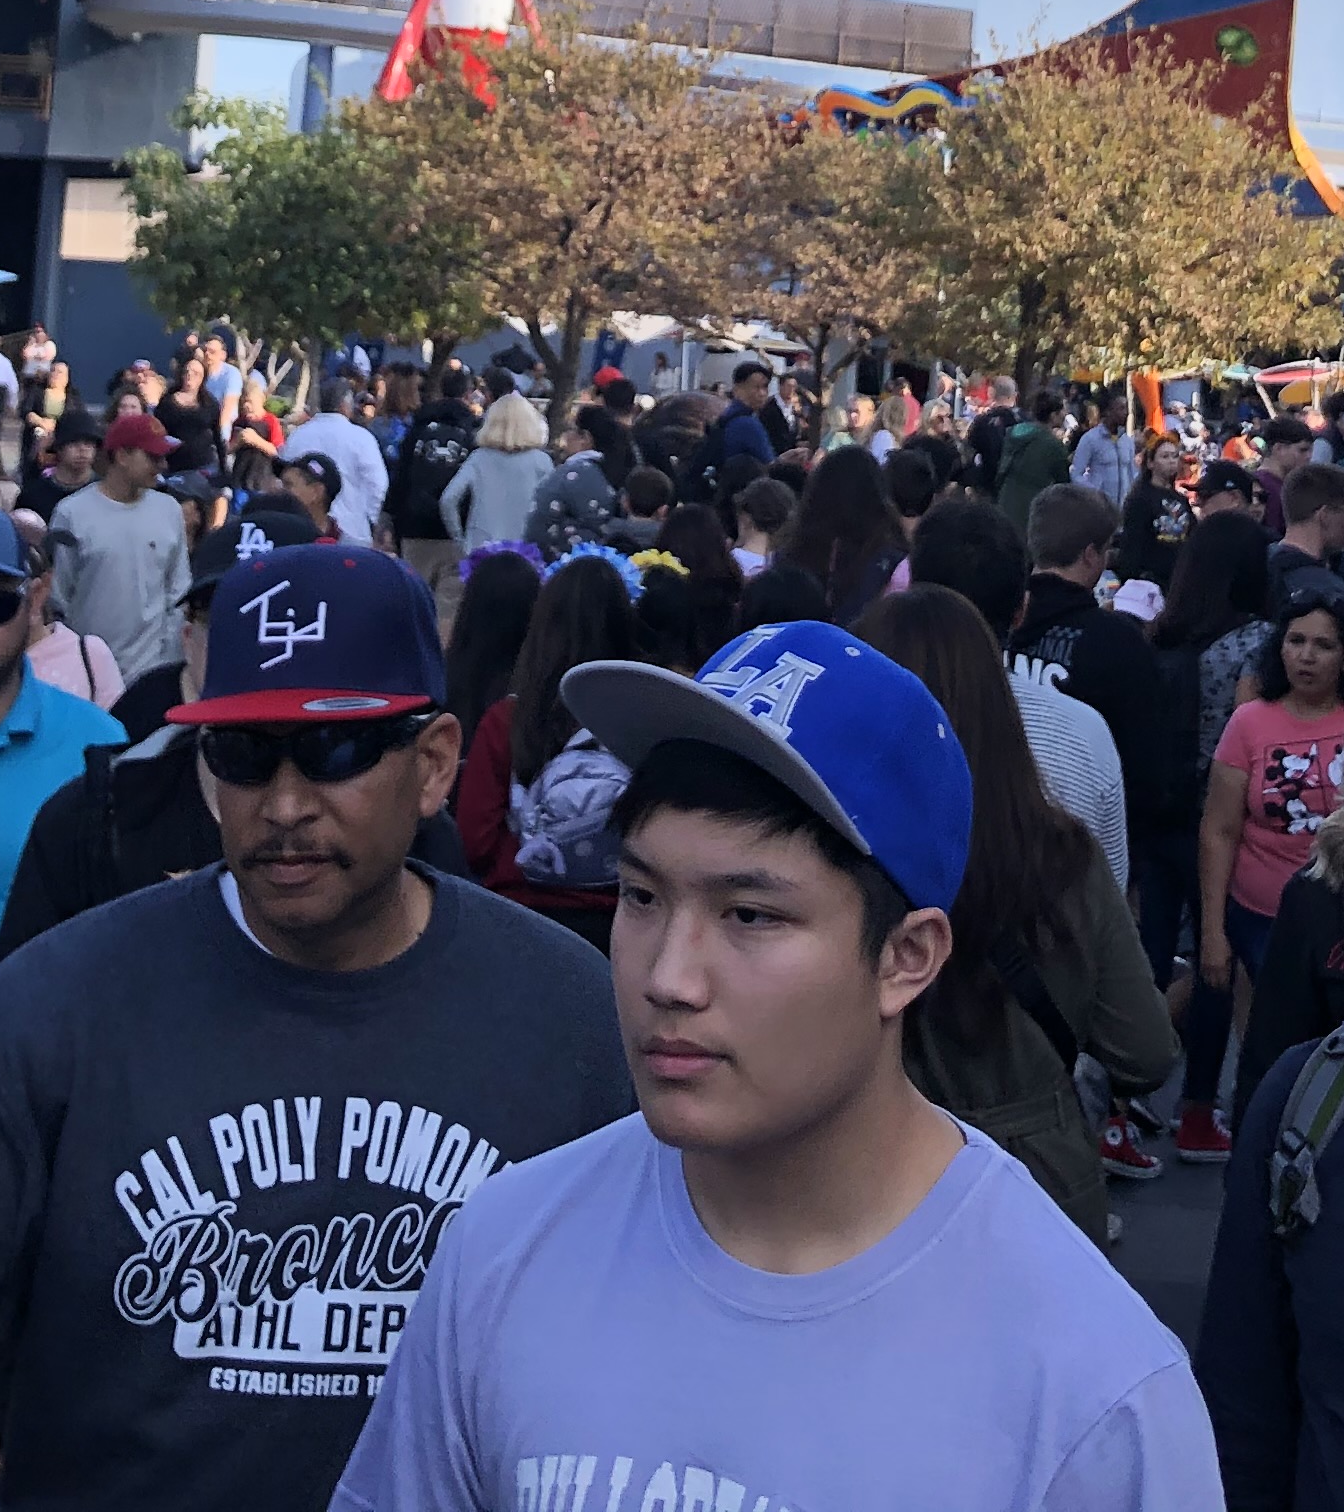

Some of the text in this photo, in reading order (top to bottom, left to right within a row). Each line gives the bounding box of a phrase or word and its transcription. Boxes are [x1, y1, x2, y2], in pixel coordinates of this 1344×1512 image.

[235, 522, 275, 561] LA
[700, 627, 827, 740] LA
[114, 1096, 514, 1243] CAL POLY POMON
[209, 1366, 360, 1397] ESTABLISHED
